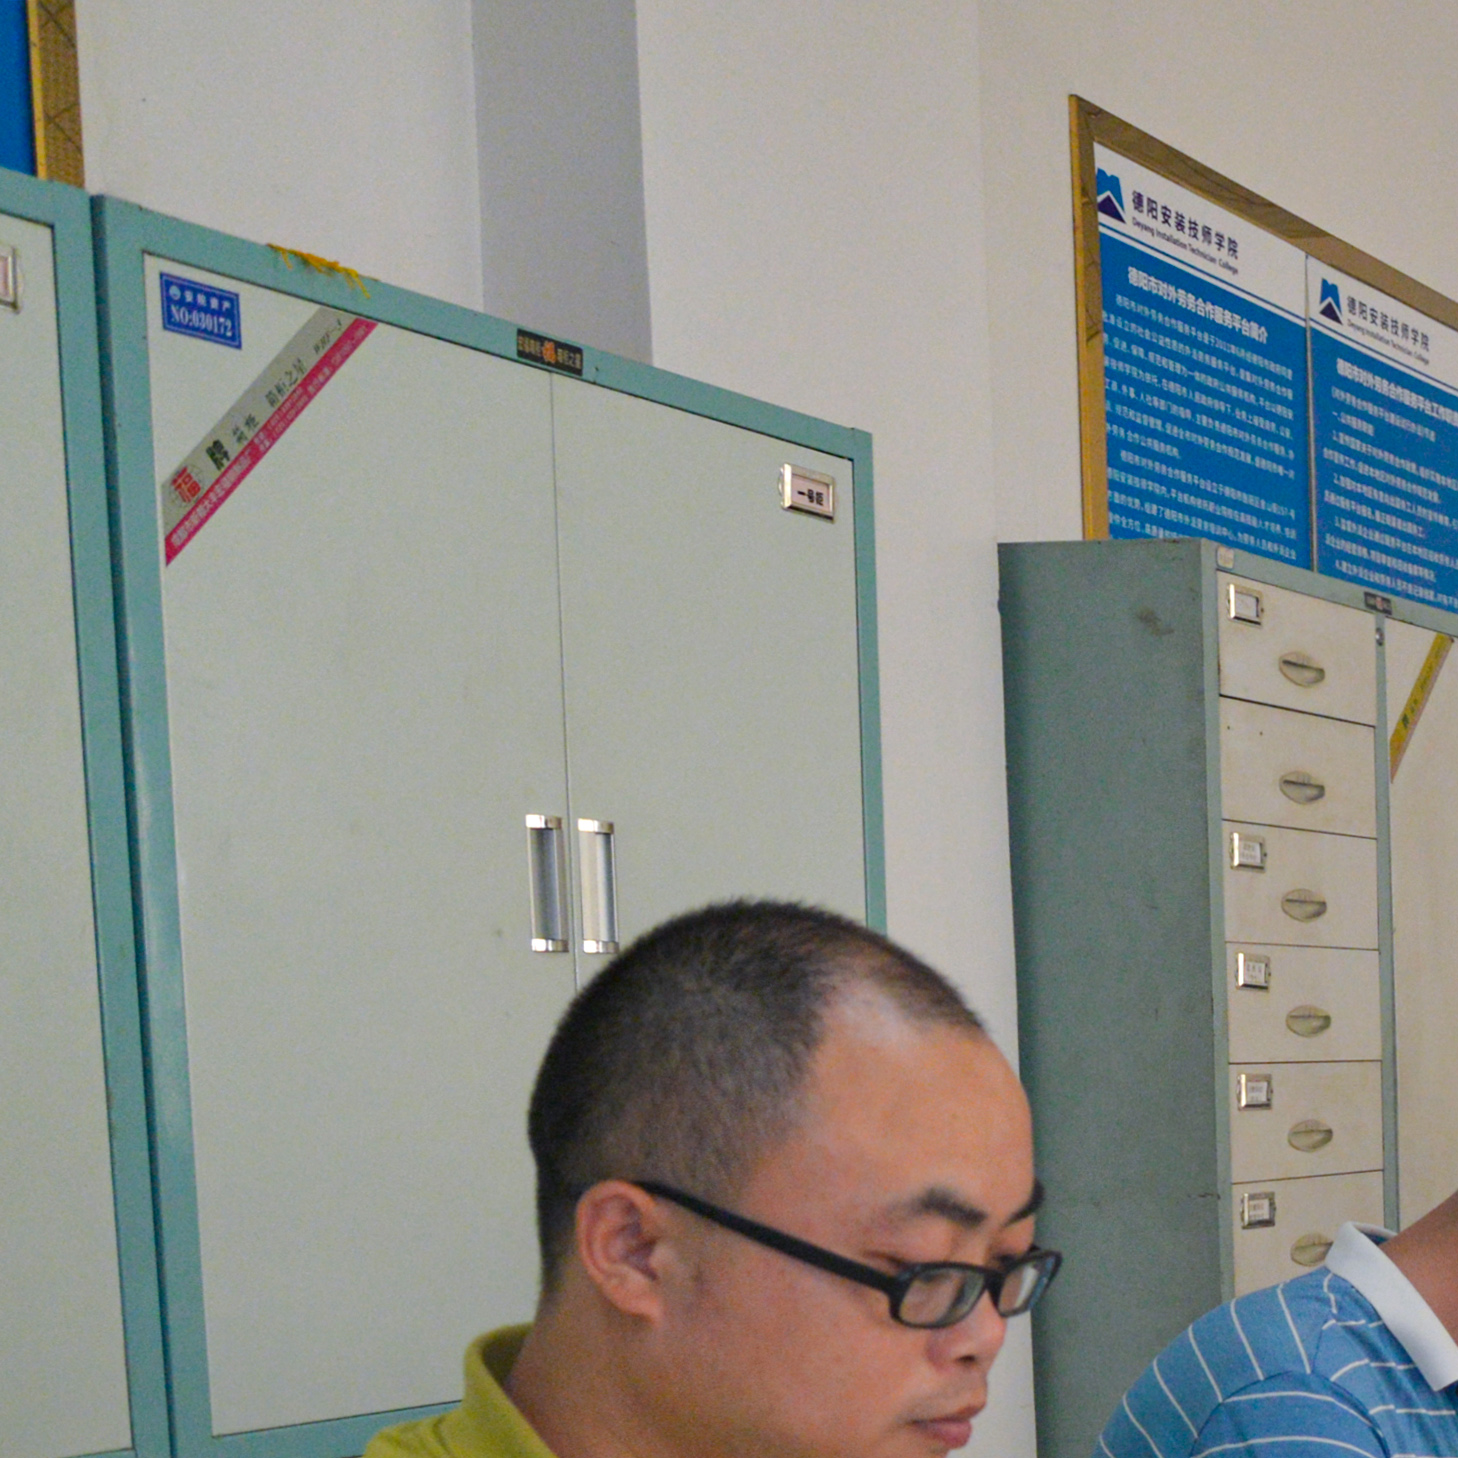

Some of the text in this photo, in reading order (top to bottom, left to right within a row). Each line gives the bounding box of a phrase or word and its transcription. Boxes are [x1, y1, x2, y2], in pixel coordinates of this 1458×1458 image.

[1132, 188, 1238, 261] 德阳安装技师学院
[1132, 216, 1238, 276] Deyang Installation Technician College
[170, 306, 233, 338] NO:030172
[1127, 265, 1268, 345] 德阳市对外劳务合作服务平台简介
[1346, 294, 1429, 353] 德阳安装技师学院
[171, 466, 202, 504] 福
